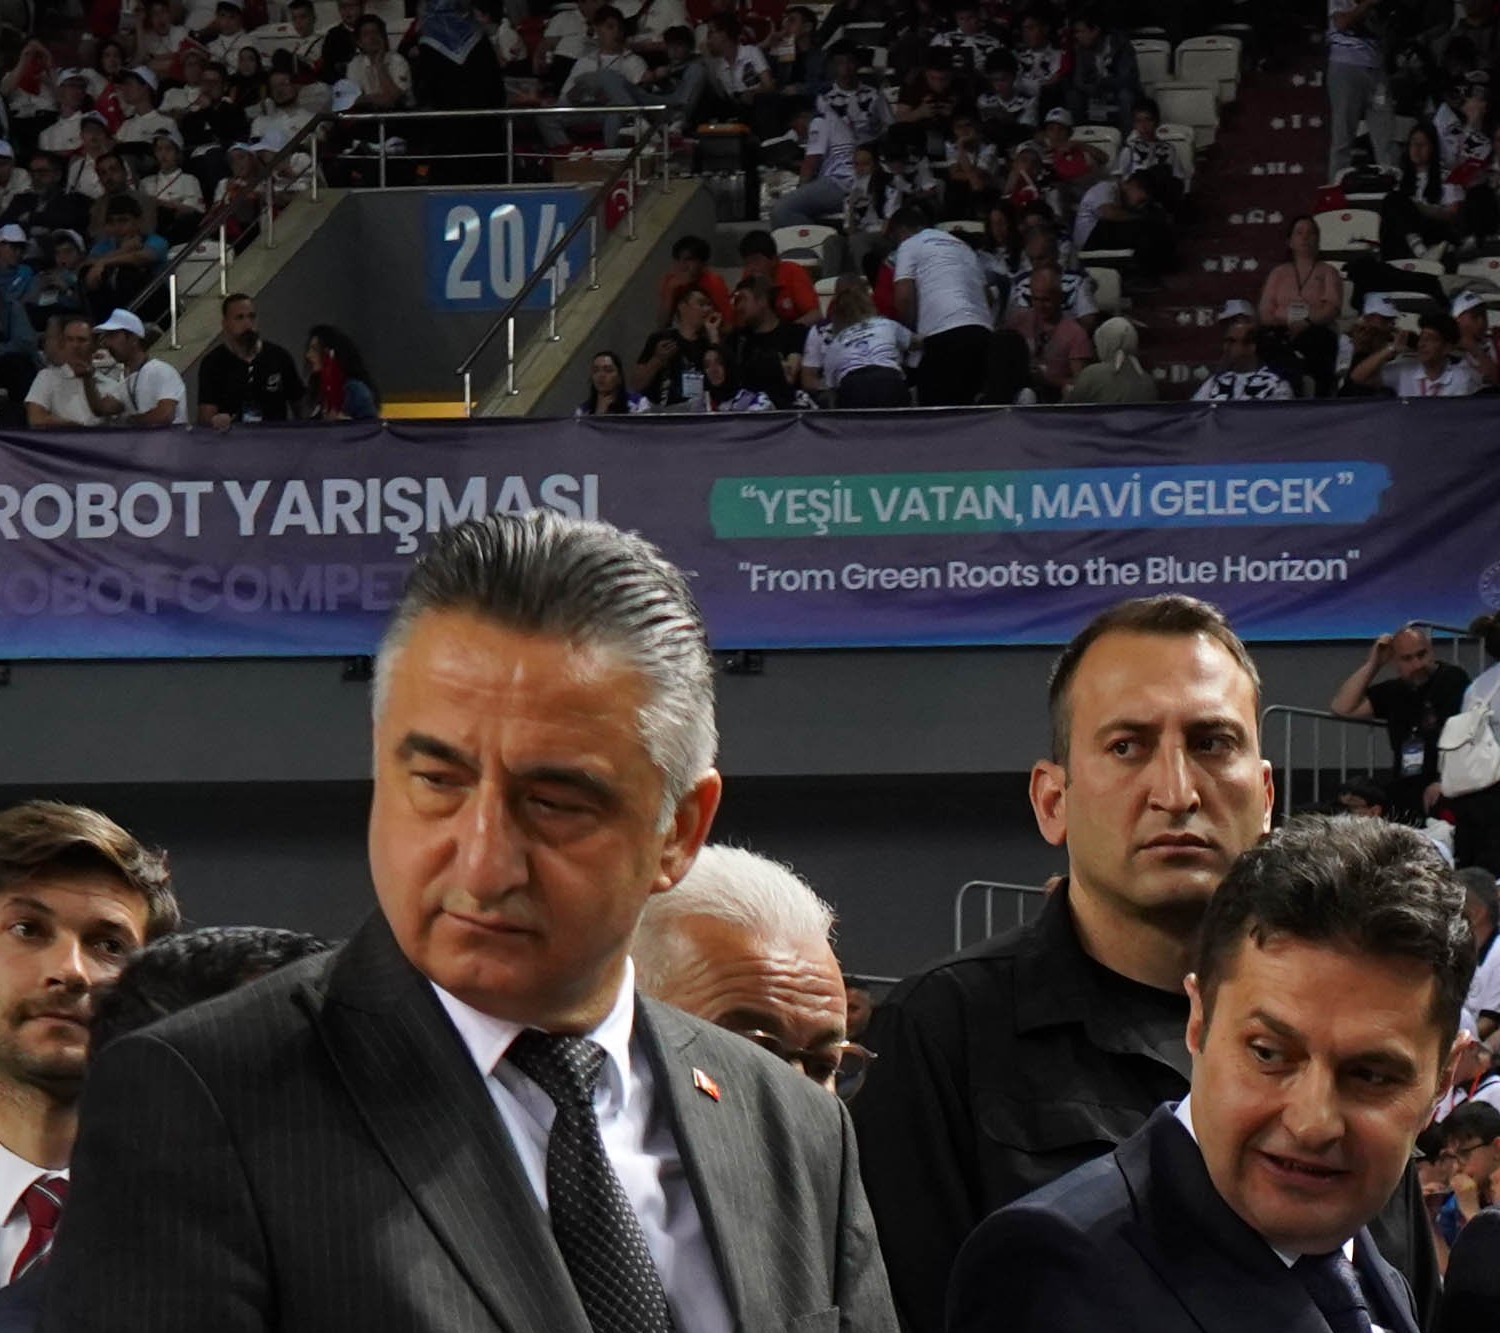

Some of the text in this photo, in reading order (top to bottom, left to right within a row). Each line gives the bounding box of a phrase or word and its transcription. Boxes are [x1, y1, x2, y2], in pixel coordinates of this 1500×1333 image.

[444, 203, 571, 299] 204
[223, 473, 600, 554] YARIŞMASI
[868, 484, 1024, 527] VATAN,
[1030, 472, 1142, 519] MAVİ
[841, 562, 942, 590] Green
[947, 560, 1040, 588] Roots
[1045, 559, 1080, 586] to
[1084, 557, 1141, 585] the
[1146, 555, 1218, 584] Blue
